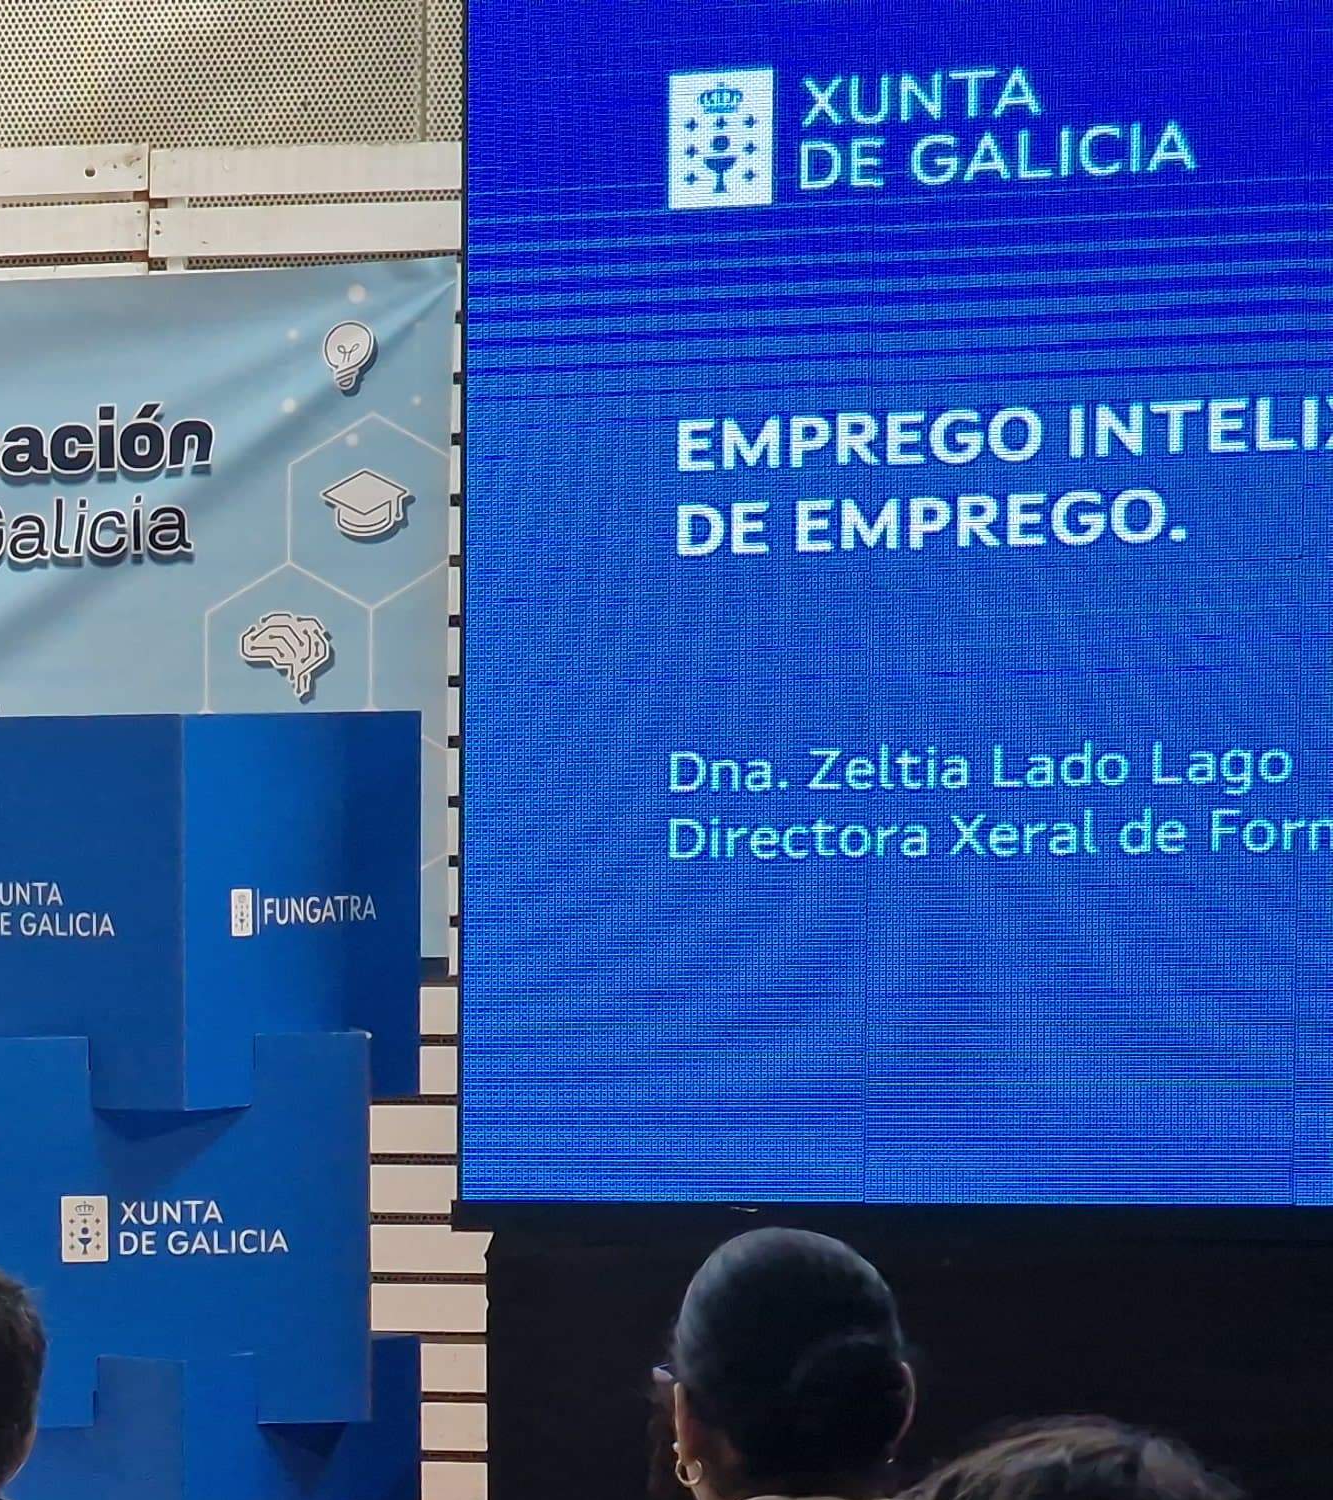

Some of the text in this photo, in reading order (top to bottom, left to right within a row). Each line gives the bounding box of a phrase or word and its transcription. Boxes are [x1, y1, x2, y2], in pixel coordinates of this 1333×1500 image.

[800, 65, 1043, 127] XUNTA
[799, 120, 1199, 190] DE GALICIA
[676, 396, 1333, 473] EMPREGO INTELI
[676, 488, 1188, 557] DE EMPREGO.
[668, 740, 1294, 795] Dna. Zeltia Lado Lago
[668, 816, 929, 859] Directora
[949, 810, 1098, 856] Xeral
[1119, 807, 1187, 855] de
[19, 911, 115, 937] GALICIA
[263, 895, 378, 925] FUNGATRA
[120, 1200, 224, 1225] XUNTA
[119, 1229, 289, 1256] DE GALICIA
